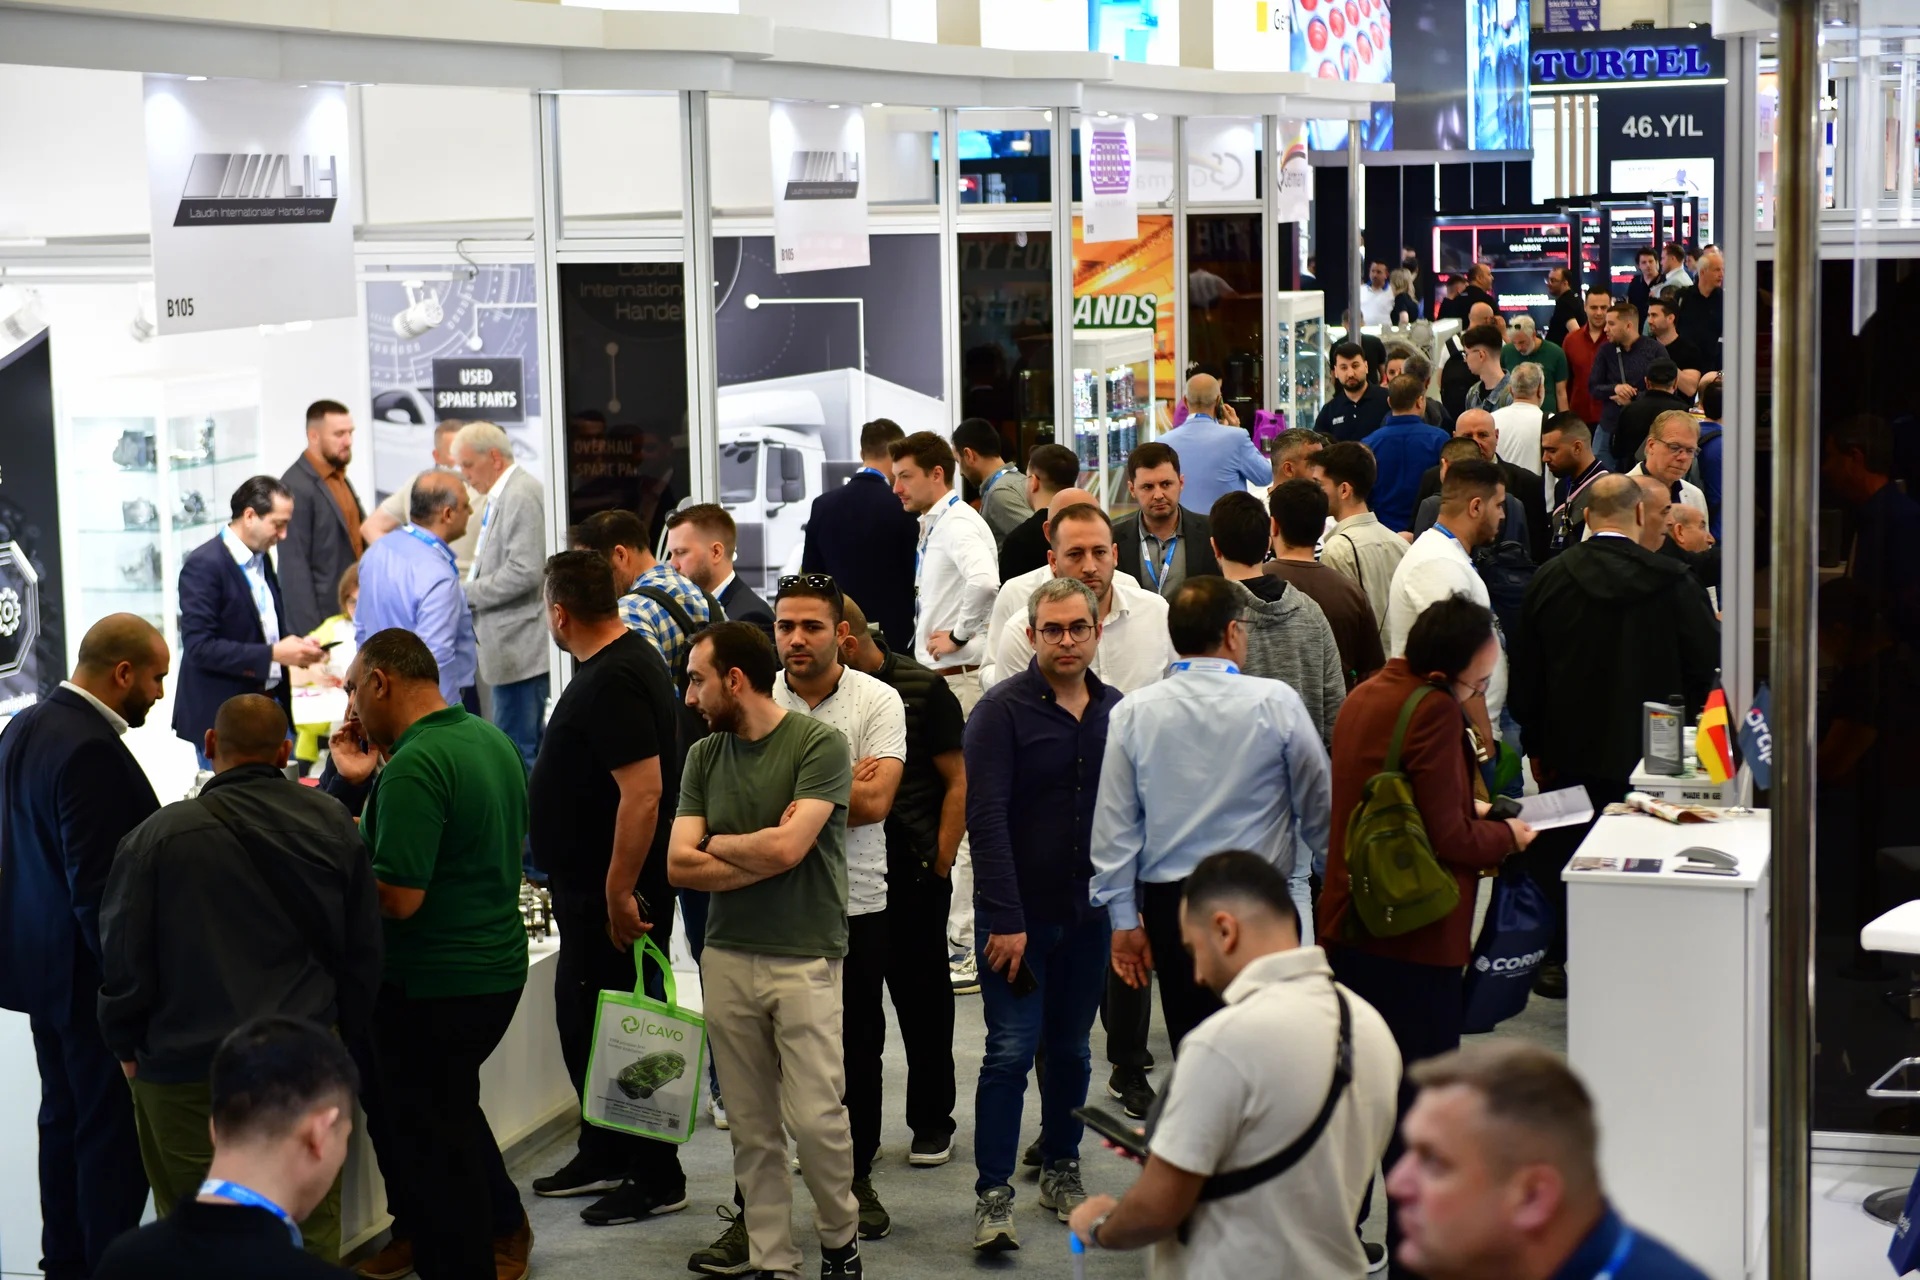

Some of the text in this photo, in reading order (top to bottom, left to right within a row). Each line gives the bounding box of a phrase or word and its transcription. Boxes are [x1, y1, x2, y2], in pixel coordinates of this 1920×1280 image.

[1533, 46, 1710, 81] TURTEL
[1621, 114, 1703, 138] 46.YIL
[189, 207, 219, 219] Laudin
[220, 207, 276, 217] Internationaler
[278, 206, 306, 216] Handel
[781, 248, 795, 261] B105
[580, 282, 684, 298] Internation
[167, 298, 195, 318] B105
[1073, 294, 1158, 325] ANDS
[460, 368, 493, 386] USED
[438, 391, 517, 408] SPARE PARTS
[647, 1024, 684, 1042] CAVO
